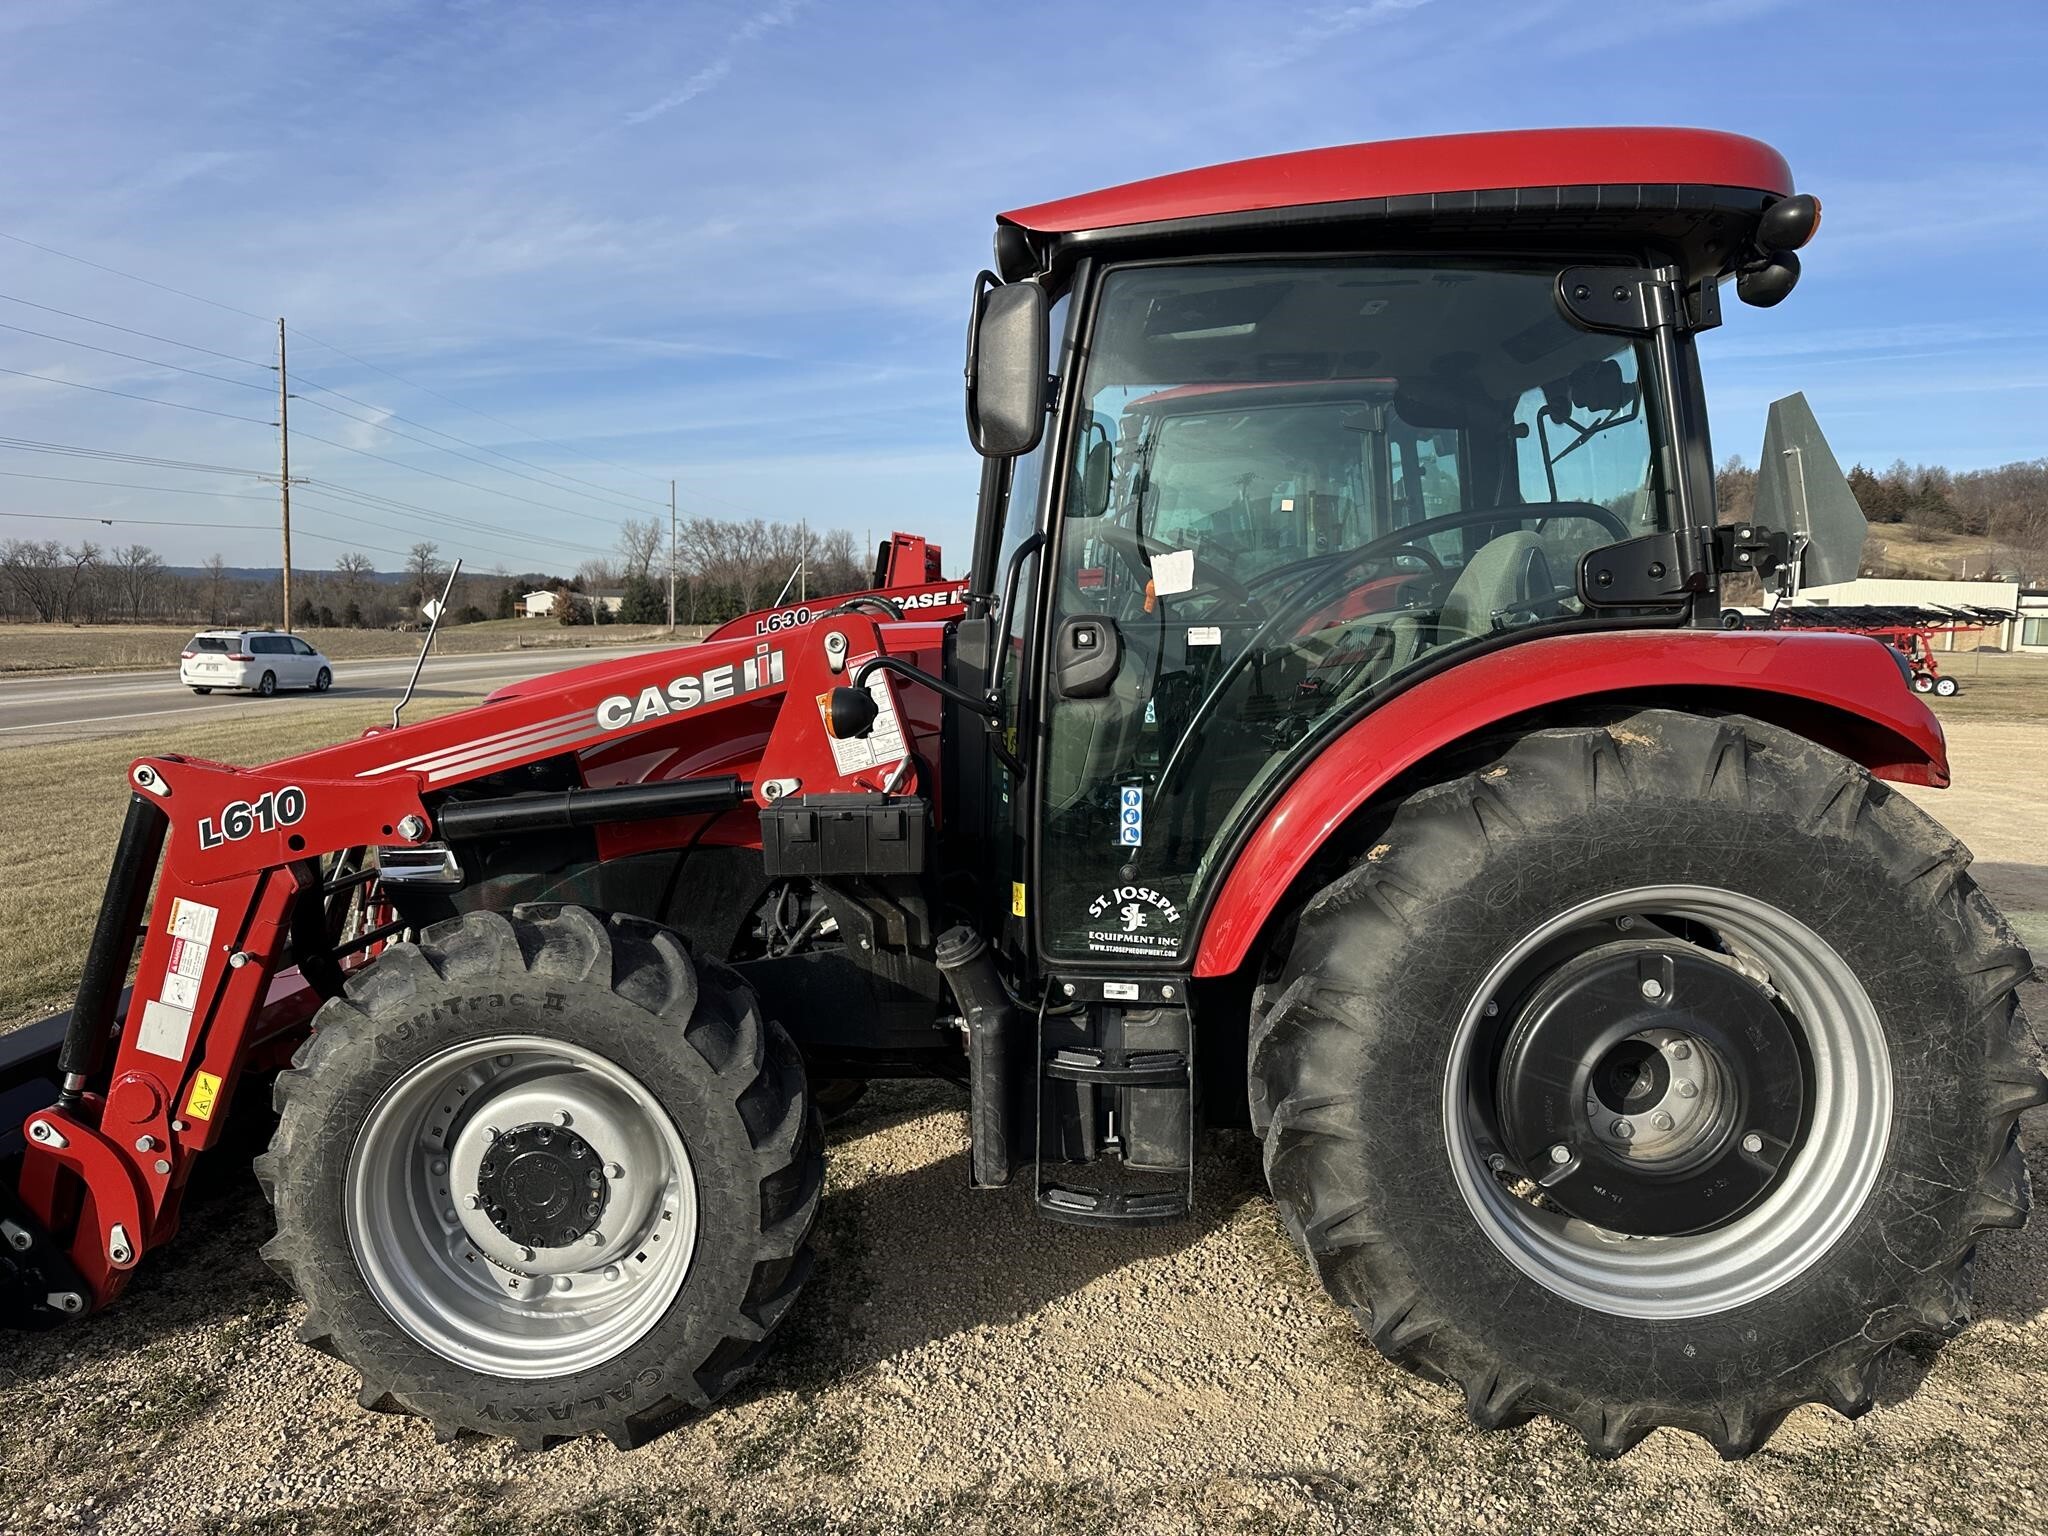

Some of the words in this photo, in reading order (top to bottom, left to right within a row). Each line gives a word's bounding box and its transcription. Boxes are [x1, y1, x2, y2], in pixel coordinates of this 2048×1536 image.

[891, 592, 947, 610] CASE
[756, 606, 812, 637] L630
[596, 663, 735, 730] CASE
[198, 785, 307, 849] L610
[1088, 895, 1111, 919] ST.
[1112, 886, 1181, 923] JOSEPH
[173, 939, 184, 966] DANGER
[1088, 931, 1155, 944] EQUIPMENT
[1157, 936, 1179, 946] INC
[374, 992, 525, 1059] AgriTrac
[476, 1366, 665, 1424] GALAXY
